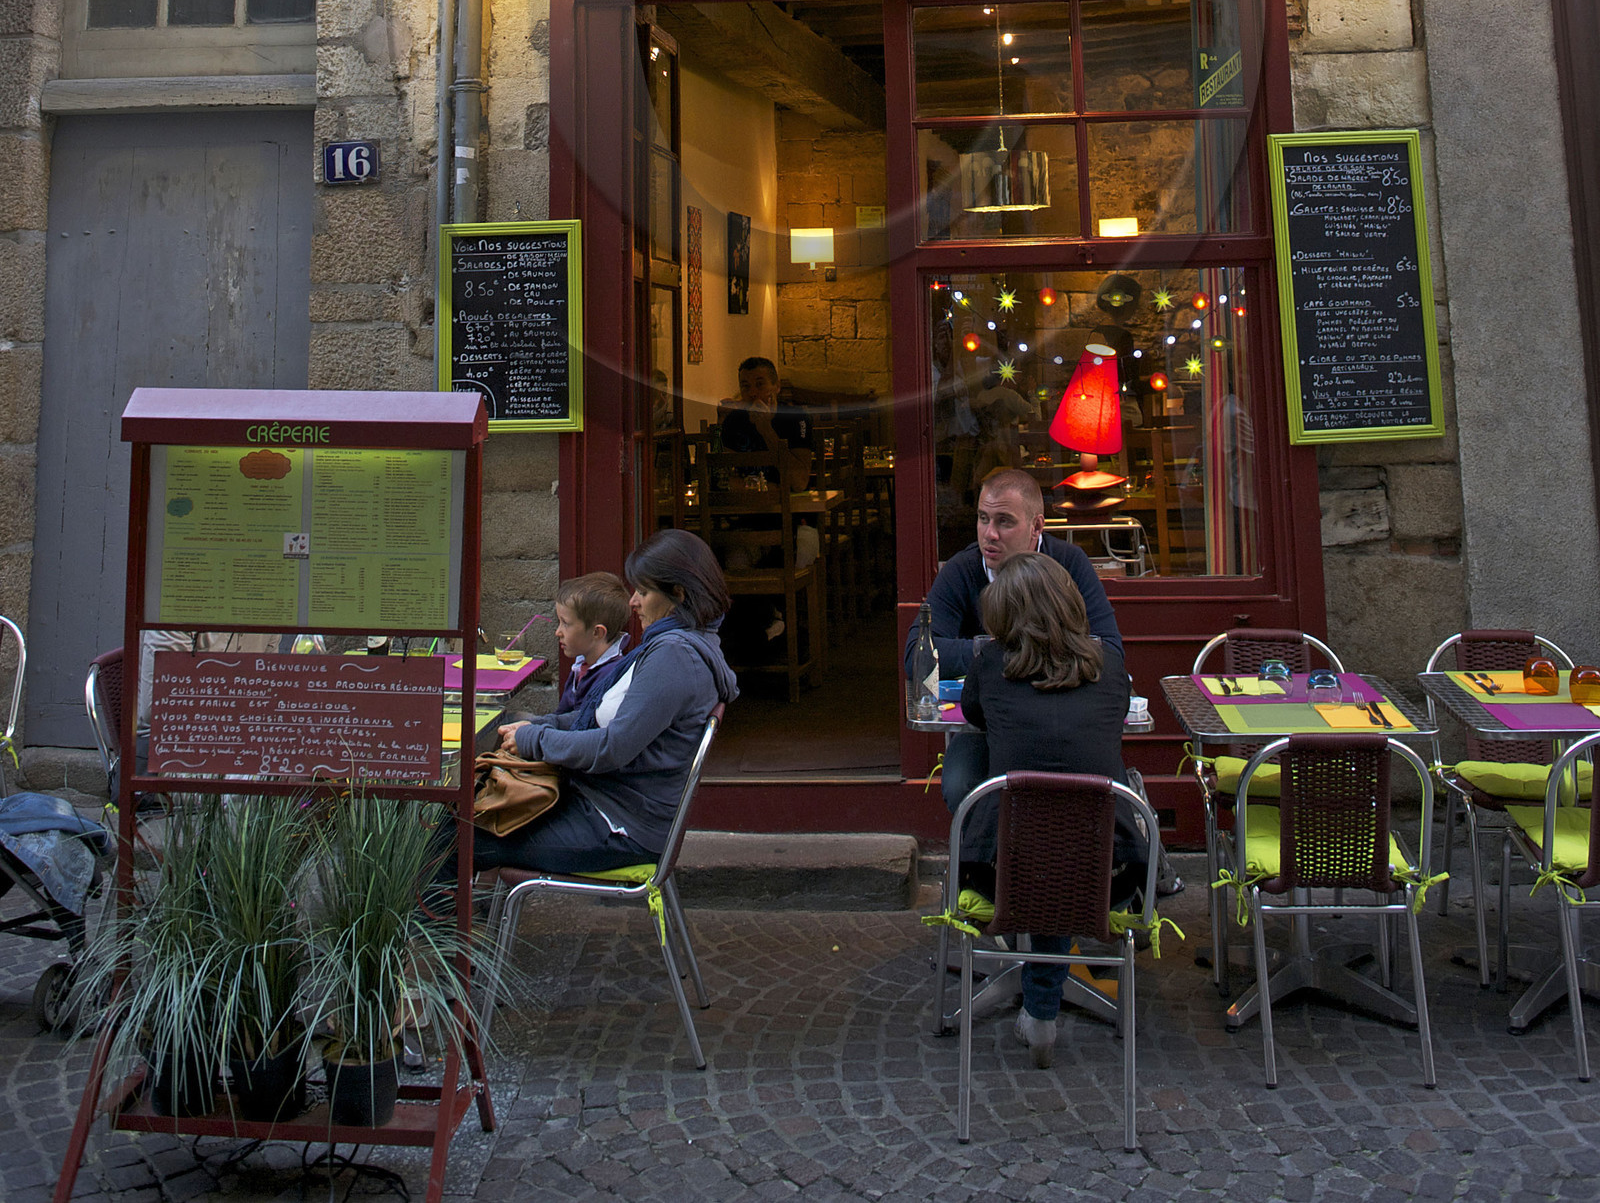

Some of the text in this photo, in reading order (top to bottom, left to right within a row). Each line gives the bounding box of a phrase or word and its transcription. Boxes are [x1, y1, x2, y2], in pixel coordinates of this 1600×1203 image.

[1200, 53, 1209, 70] R
[1200, 51, 1241, 104] RESTAURANT
[331, 146, 371, 179] 16
[246, 421, 331, 444] CRÊPERIE
